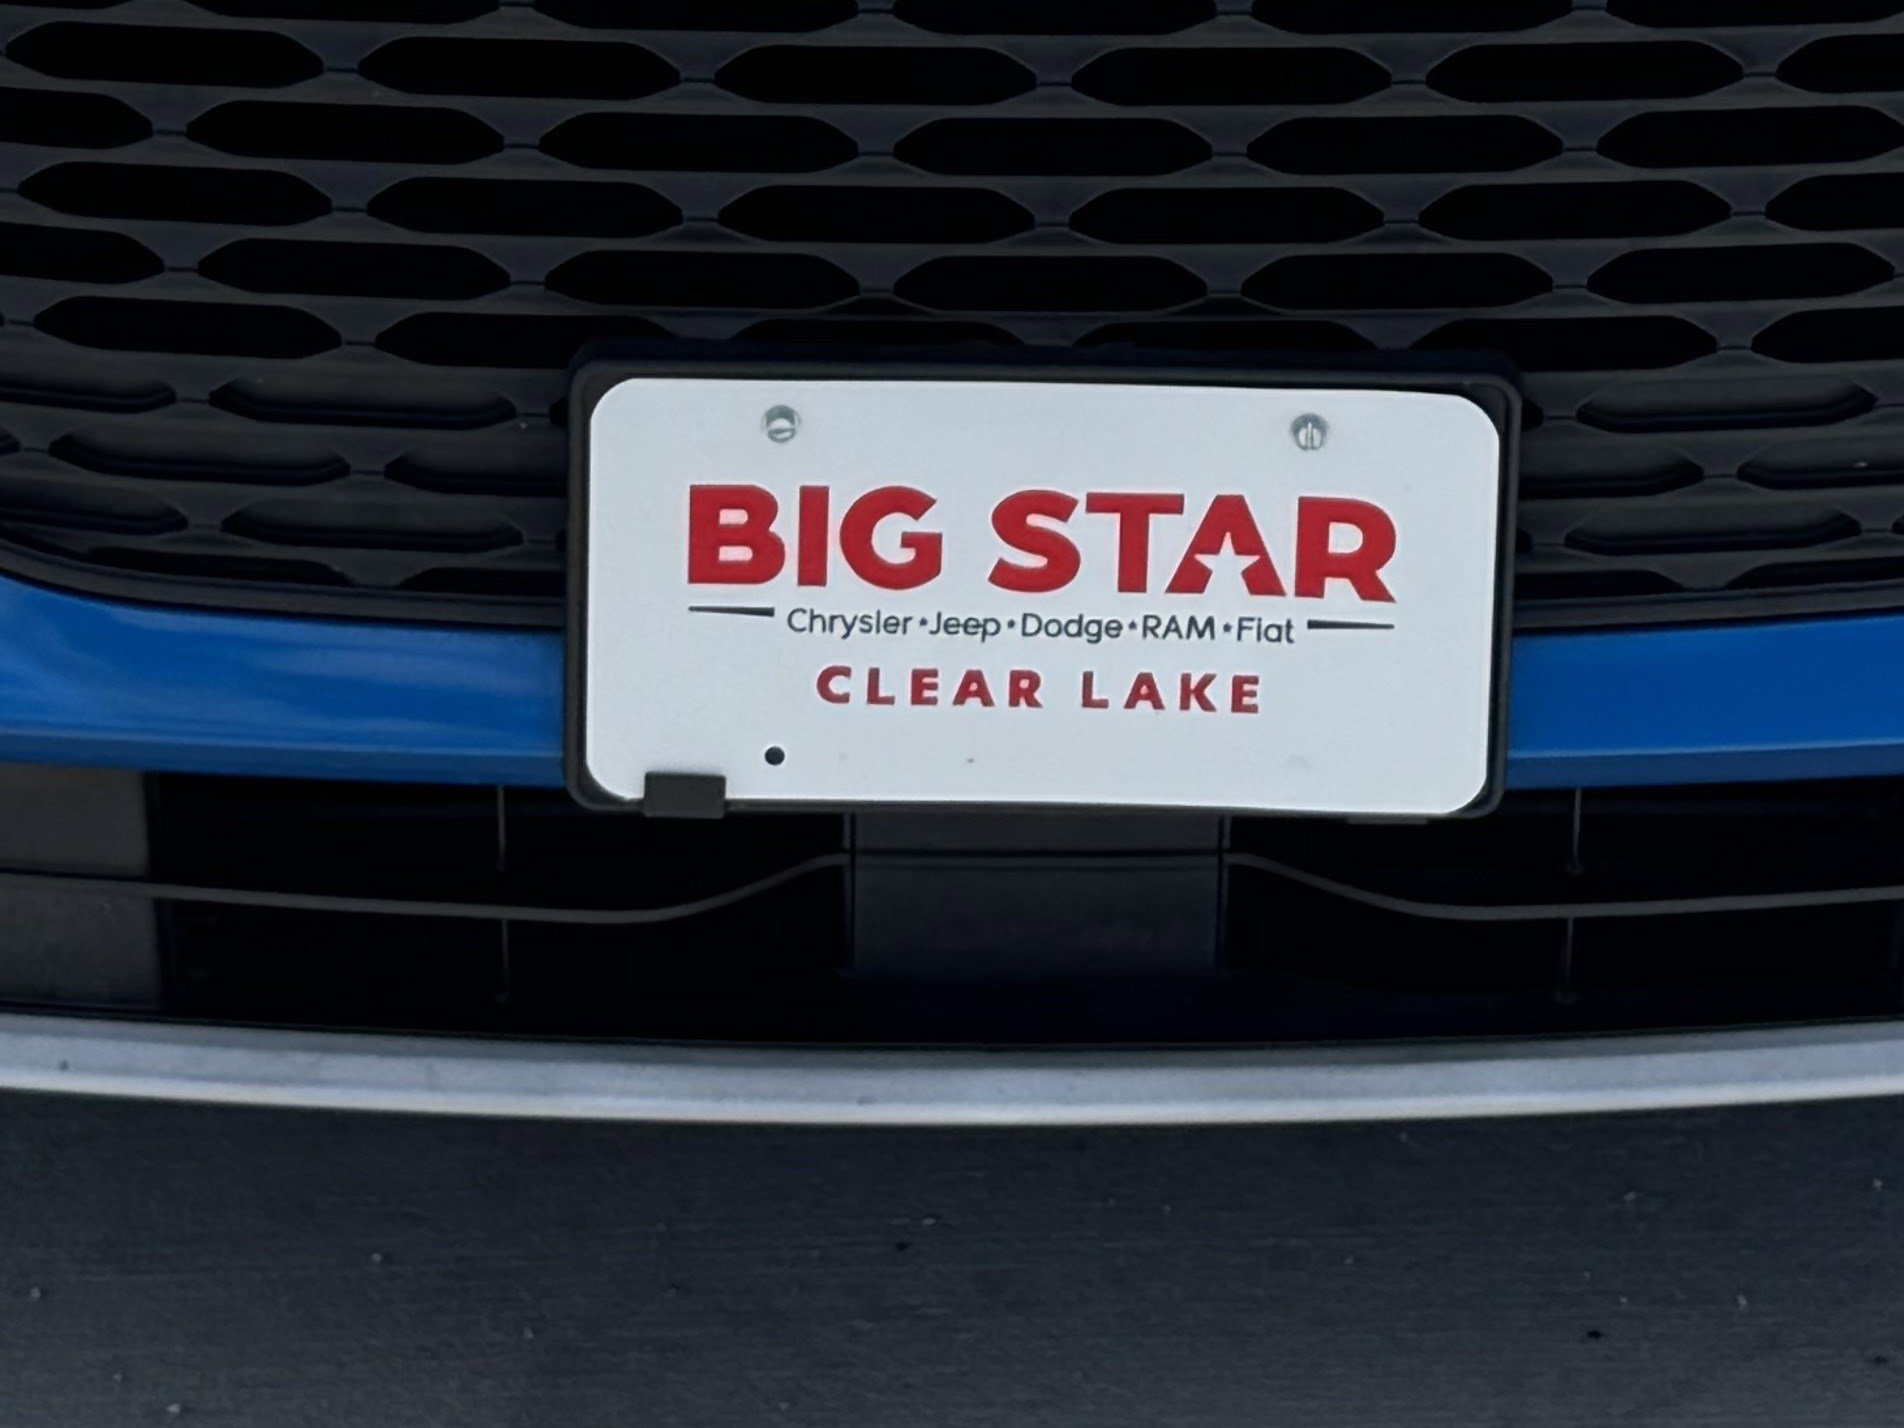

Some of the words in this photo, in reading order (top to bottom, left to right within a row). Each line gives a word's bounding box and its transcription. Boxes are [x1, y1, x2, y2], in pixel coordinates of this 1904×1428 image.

[687, 484, 943, 590] BIG
[987, 489, 1396, 603] STAR
[787, 607, 913, 640] Chrysler
[929, 611, 1002, 643] Jeep
[1021, 612, 1123, 644] Dodge
[1142, 614, 1216, 640] RAM
[1236, 616, 1295, 644] Fiat
[816, 665, 1043, 708] CLEAR
[1081, 670, 1260, 714] LAKE
